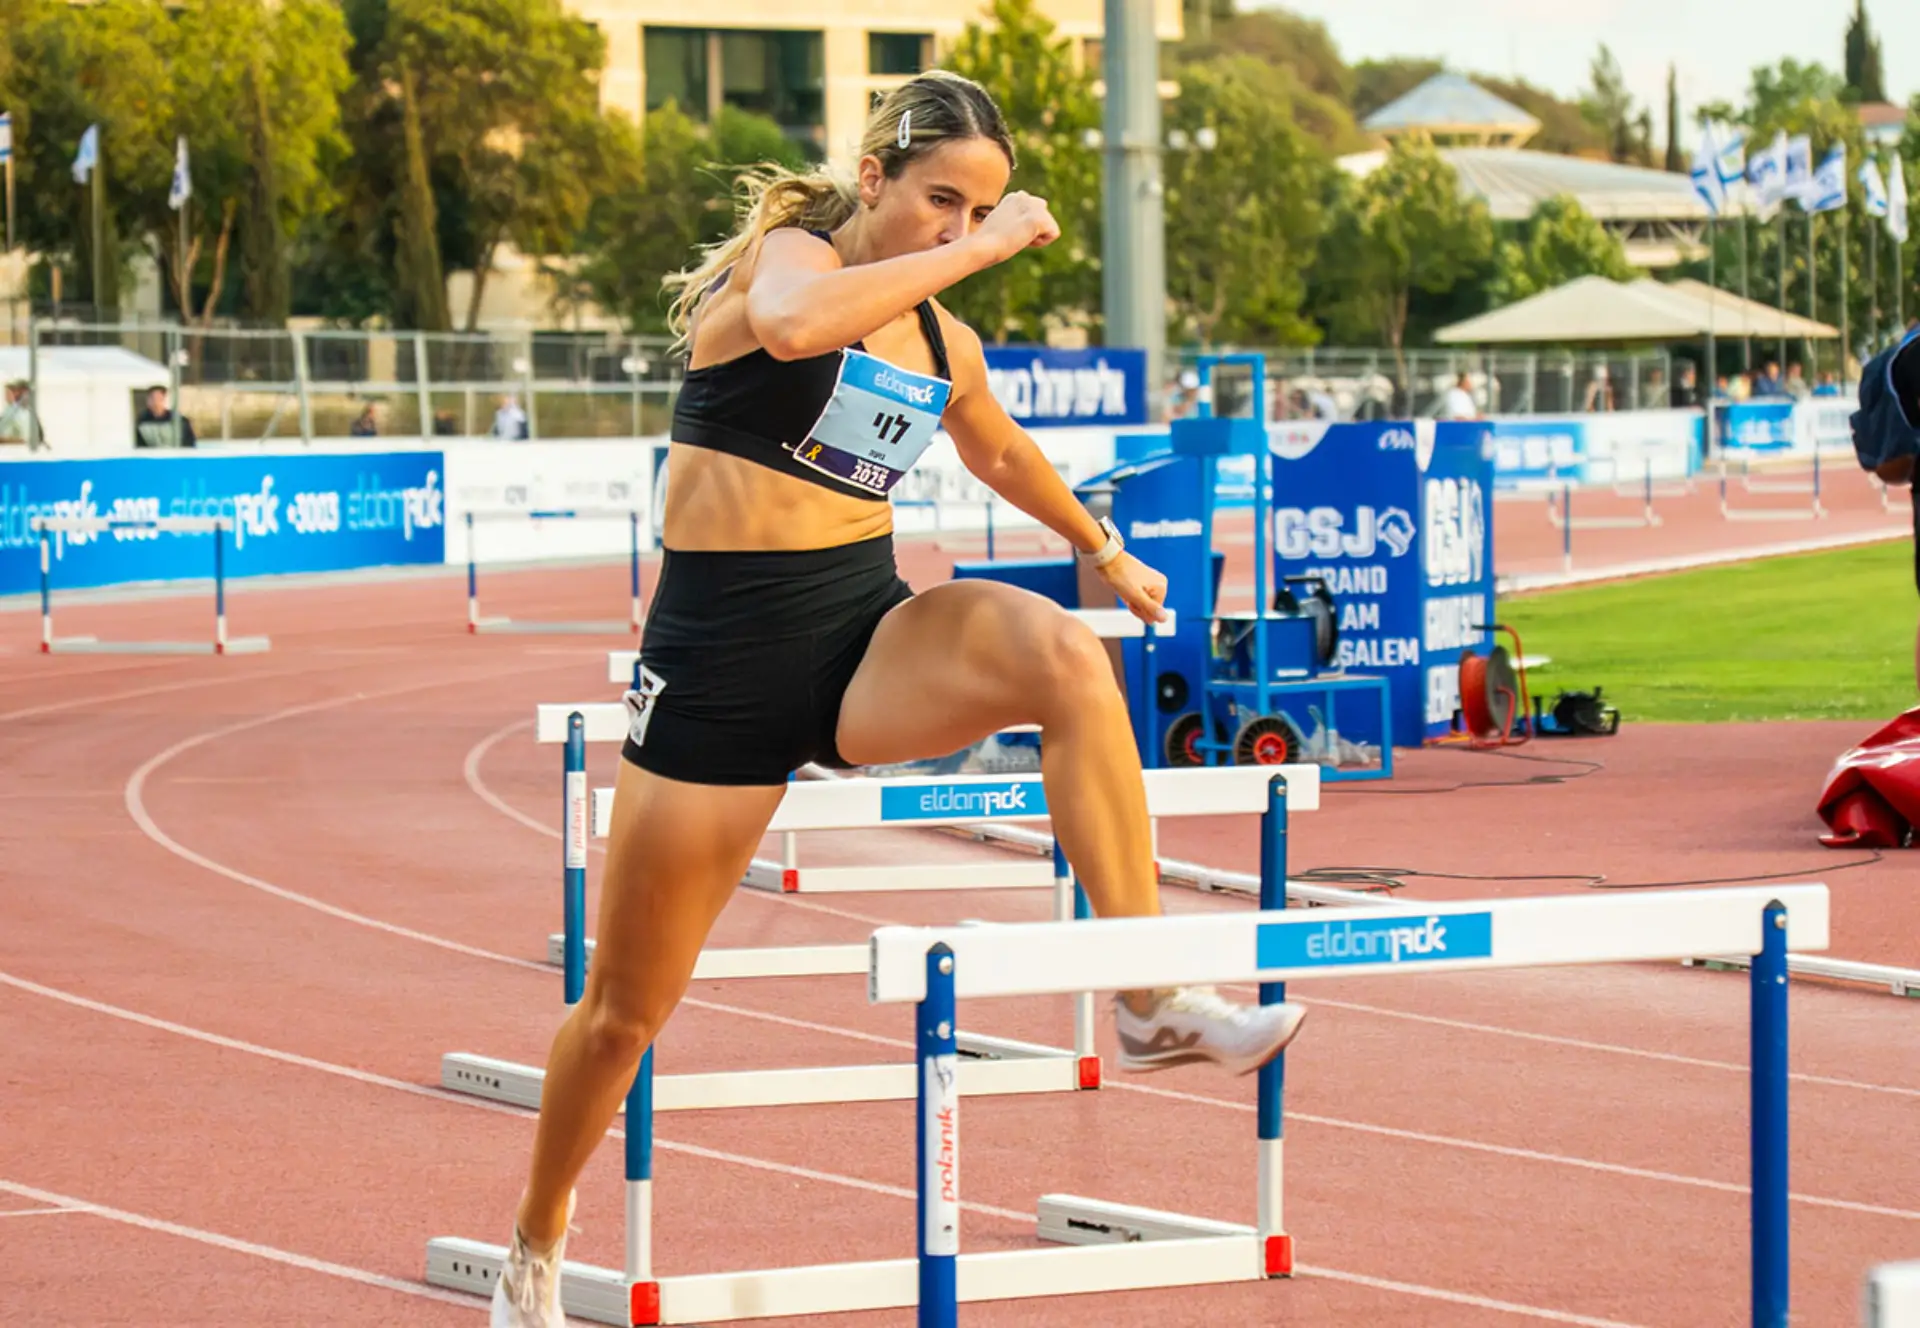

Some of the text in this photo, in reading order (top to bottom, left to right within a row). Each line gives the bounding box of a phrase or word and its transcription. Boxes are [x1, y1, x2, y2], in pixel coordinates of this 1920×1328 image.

[873, 412, 912, 445] לוי
[850, 464, 888, 489] 2025
[1274, 504, 1377, 560] GSJ
[1339, 603, 1380, 631] AM
[1334, 638, 1420, 667] SALEM
[1306, 921, 1390, 958] eldan
[935, 1105, 955, 1203] polanik
